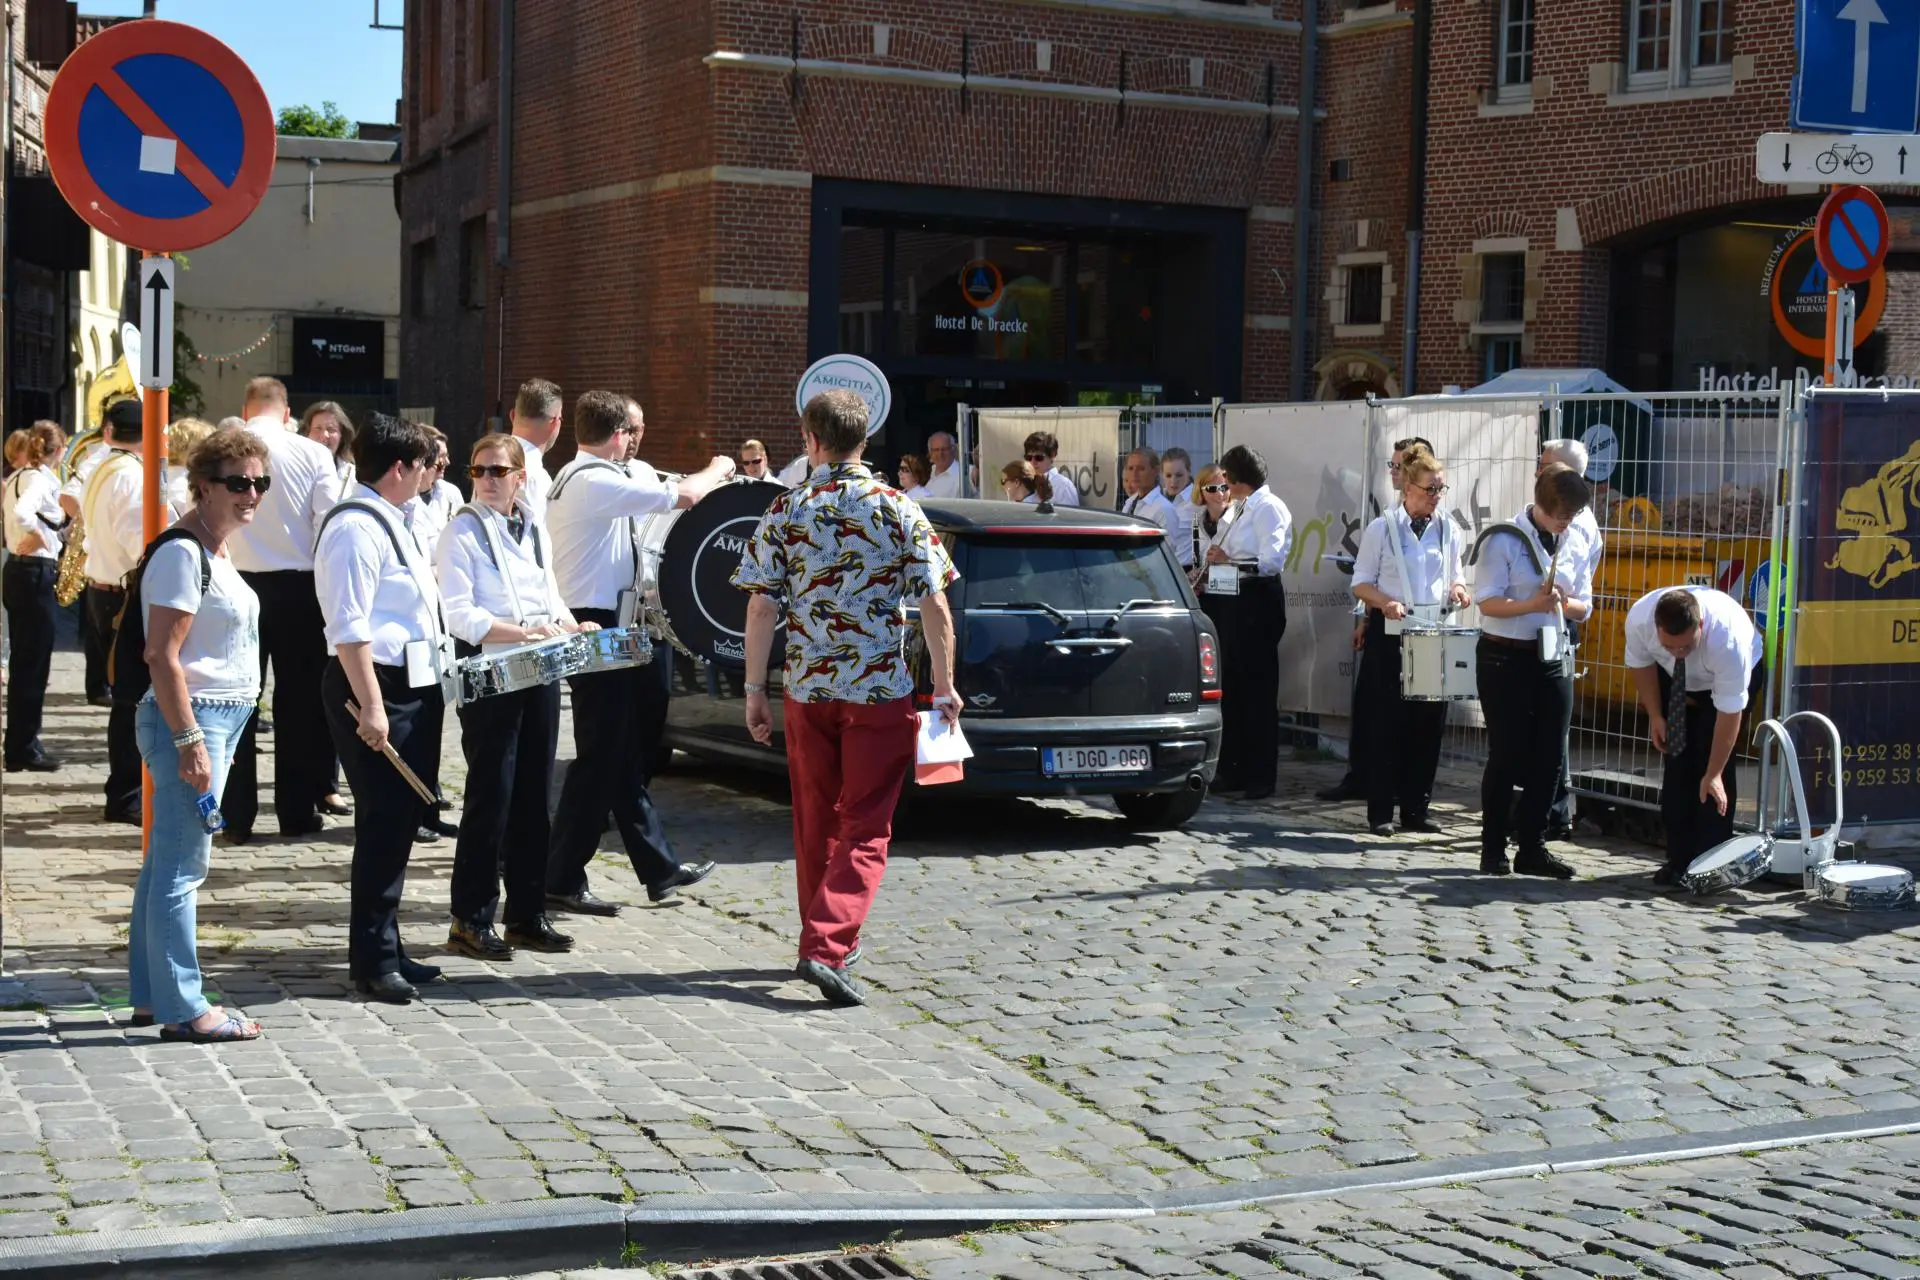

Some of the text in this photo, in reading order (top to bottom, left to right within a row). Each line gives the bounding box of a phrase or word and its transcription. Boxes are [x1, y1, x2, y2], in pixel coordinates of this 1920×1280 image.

[1760, 243, 1785, 297] BELGIUM
[935, 315, 1028, 333] Hostel De Draecke
[329, 344, 366, 353] NTGent
[812, 374, 873, 392] AMICITIA
[1700, 366, 1778, 402] Hostel
[1892, 619, 1920, 643] DE
[1857, 744, 1887, 761] 252
[1892, 743, 1911, 760] 38
[1815, 771, 1823, 788] F
[1856, 768, 1886, 786] 252
[1891, 768, 1911, 784] 53
